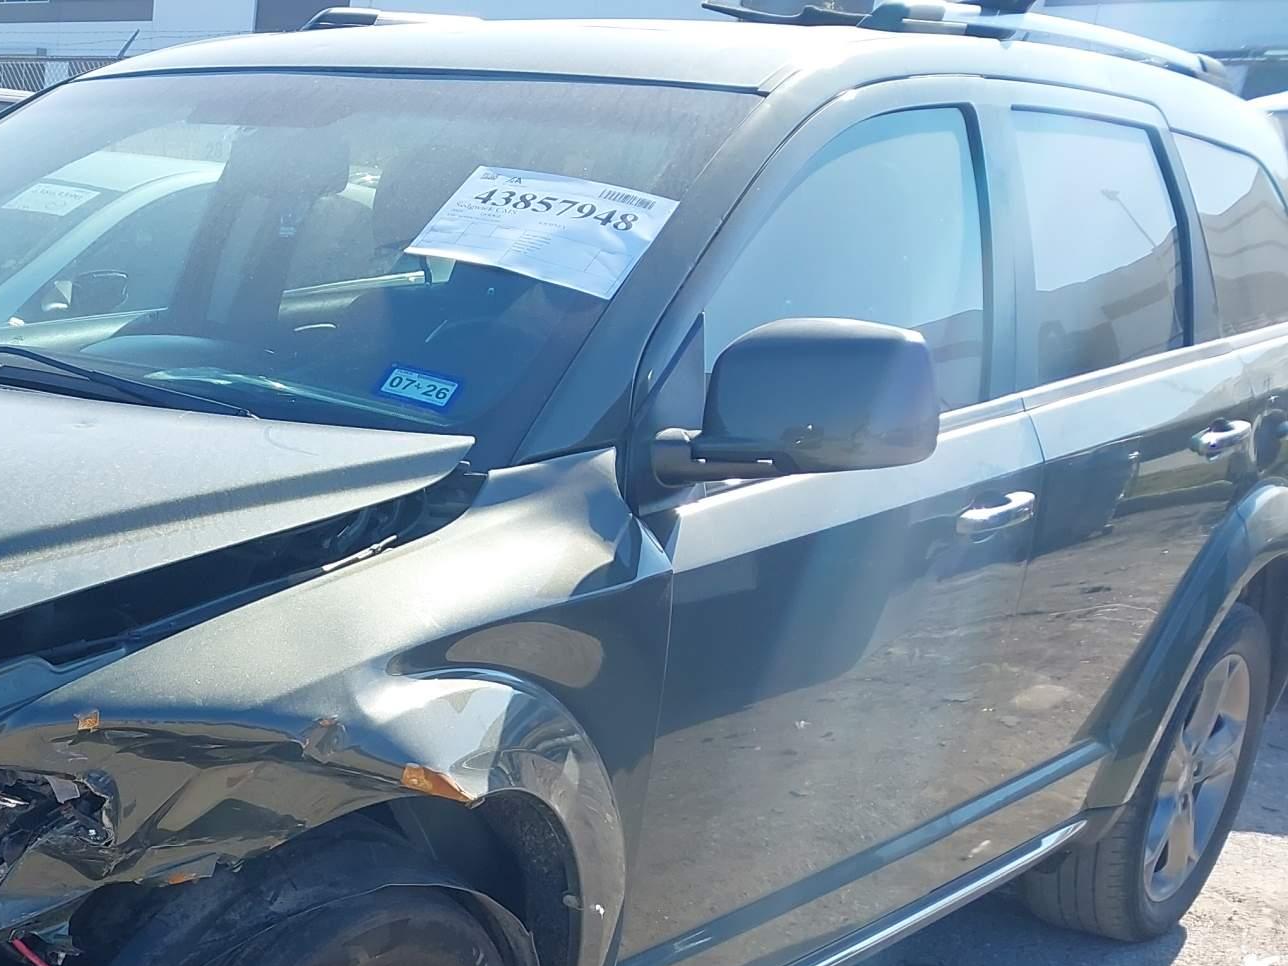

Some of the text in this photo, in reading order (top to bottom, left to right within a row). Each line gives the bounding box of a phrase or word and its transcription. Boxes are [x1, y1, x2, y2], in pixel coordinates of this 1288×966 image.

[474, 188, 639, 231] 43857948
[389, 376, 450, 400] 07 26
